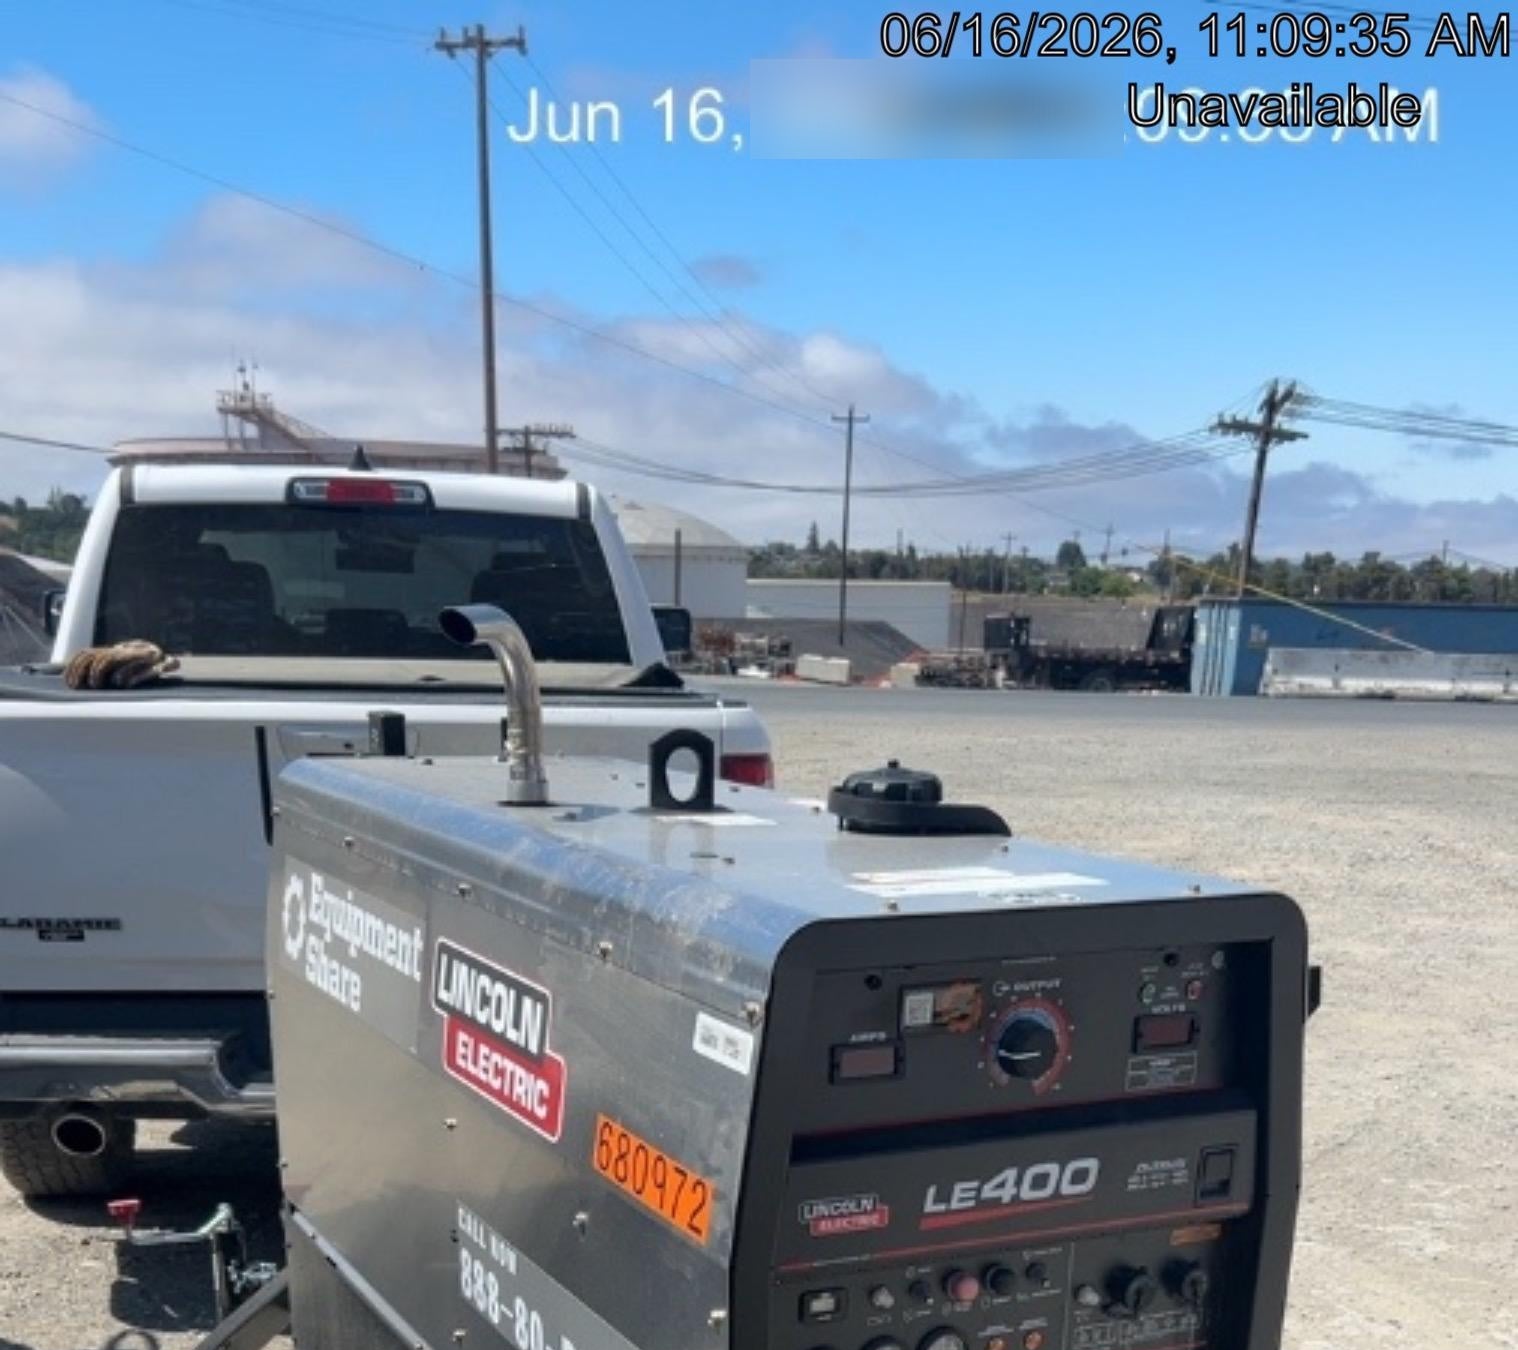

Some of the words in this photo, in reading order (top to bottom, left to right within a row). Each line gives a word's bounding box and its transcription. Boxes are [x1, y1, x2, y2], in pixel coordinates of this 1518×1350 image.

[308, 872, 424, 982] Equipment
[305, 932, 361, 1012] Share
[437, 953, 543, 1055] LINCOLN
[456, 1030, 549, 1119] ELECTRIC
[599, 1120, 707, 1235] 680972
[803, 1198, 875, 1219] LINCOLN
[923, 1157, 1099, 1213] LE400
[458, 1207, 486, 1250] CALL
